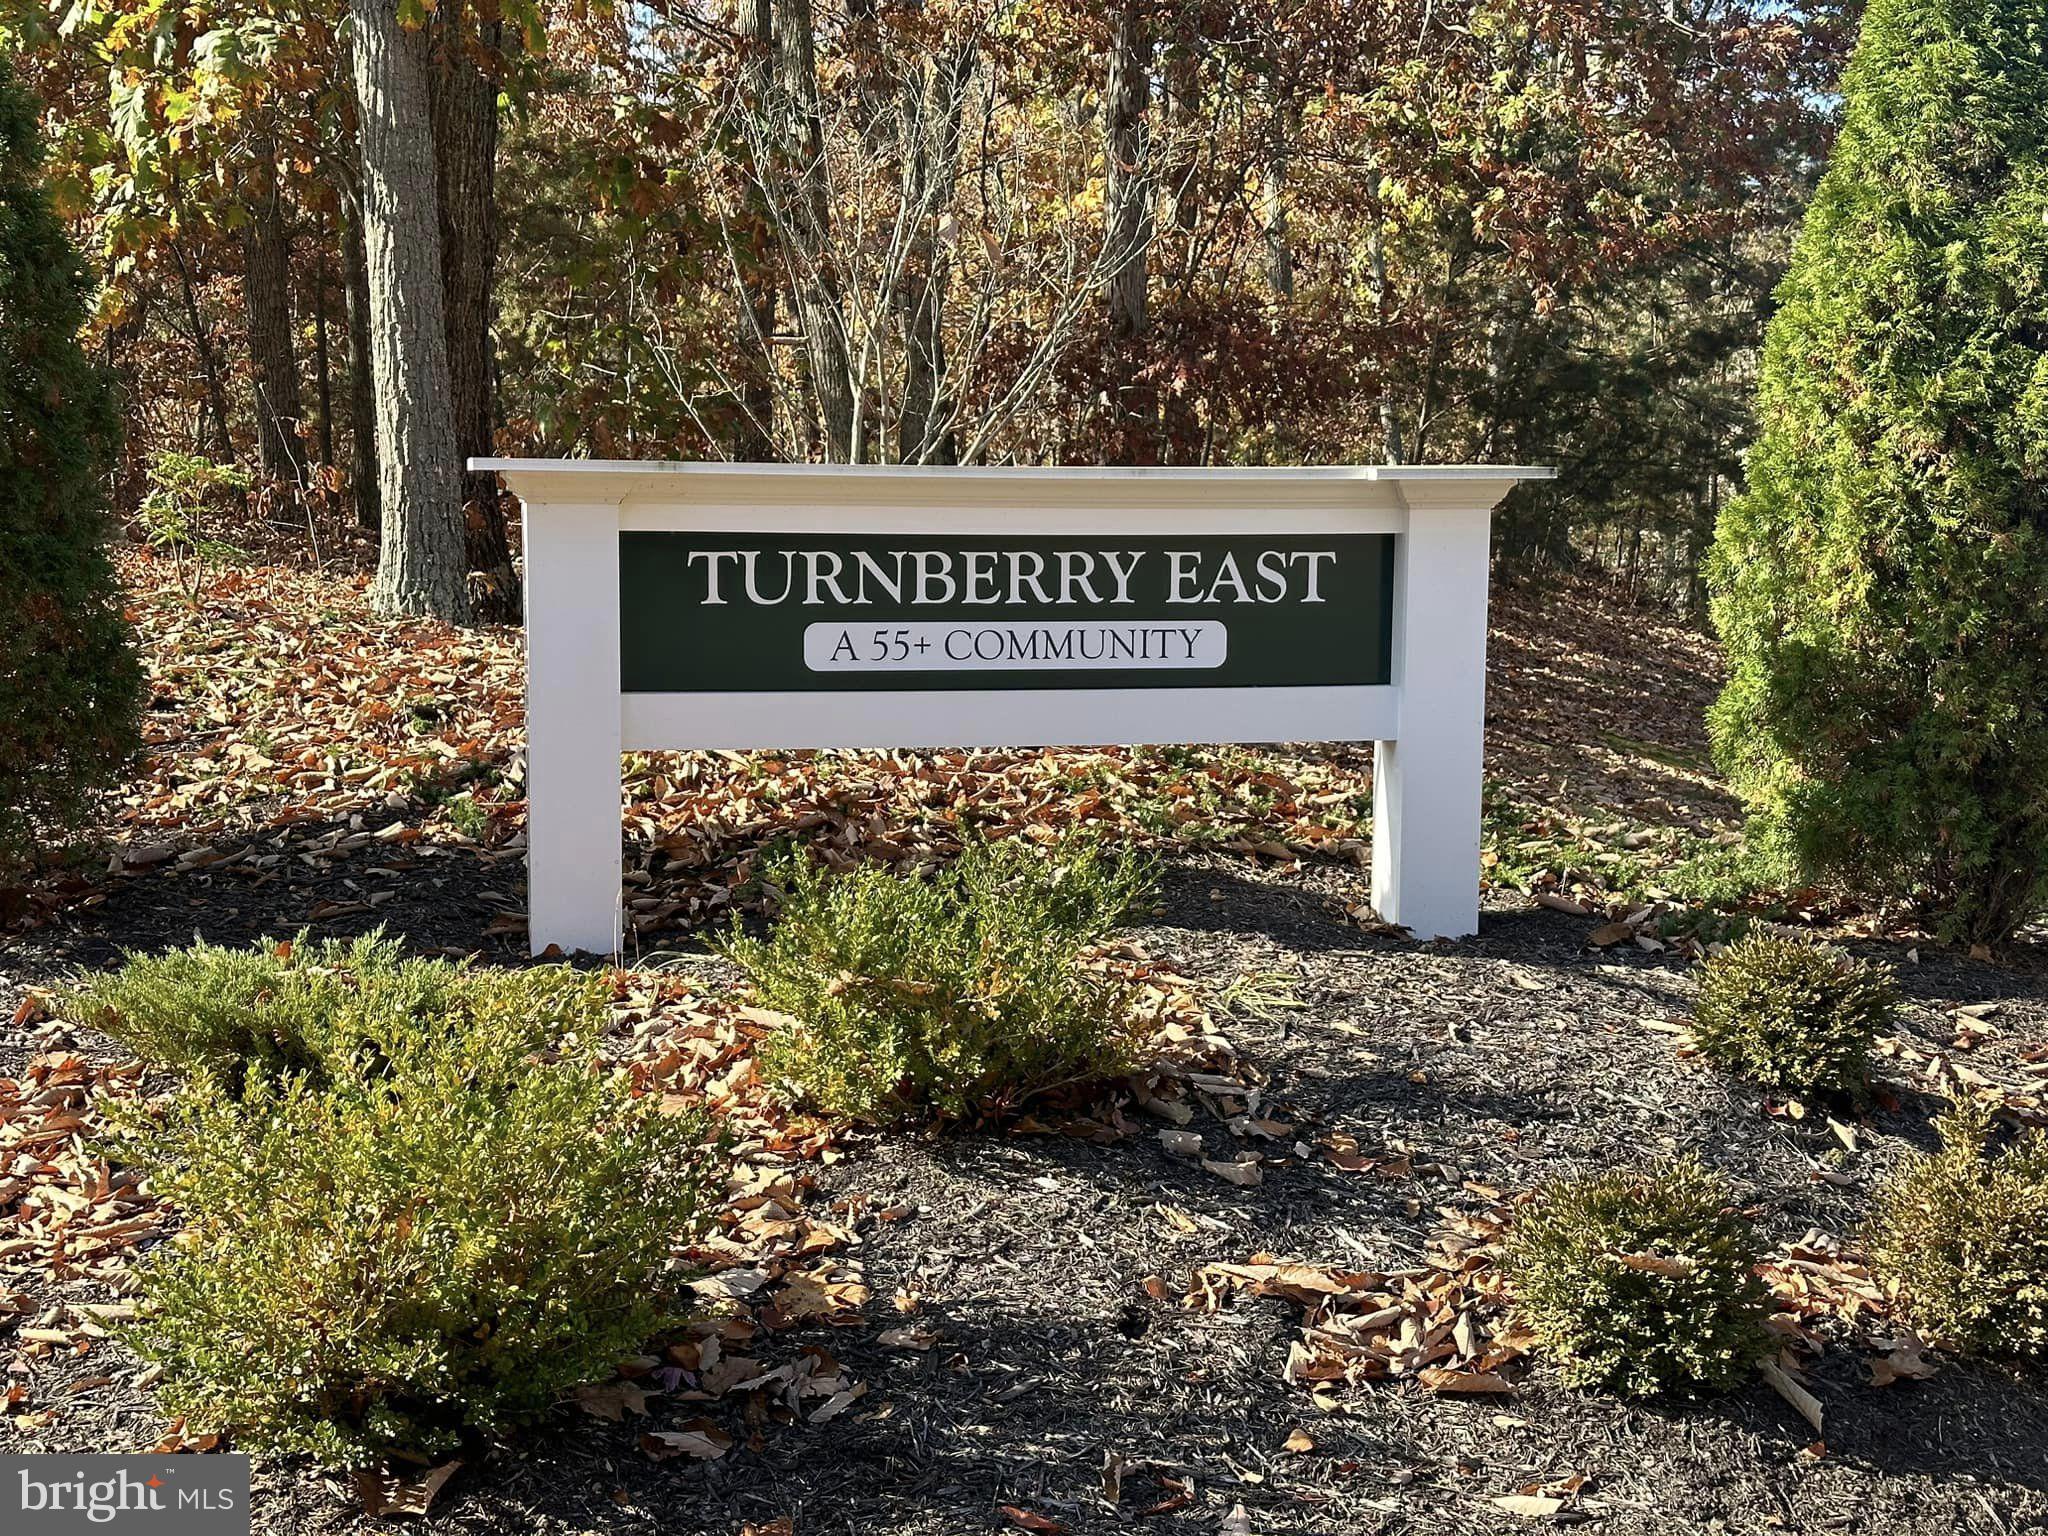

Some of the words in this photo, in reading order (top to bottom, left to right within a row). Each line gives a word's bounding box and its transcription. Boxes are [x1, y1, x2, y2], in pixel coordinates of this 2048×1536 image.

[687, 550, 1147, 605] TURNBERRY
[1163, 550, 1337, 604] EAST
[829, 629, 861, 662] A
[870, 629, 932, 662] 55+
[944, 628, 1203, 662] COMMUNITY
